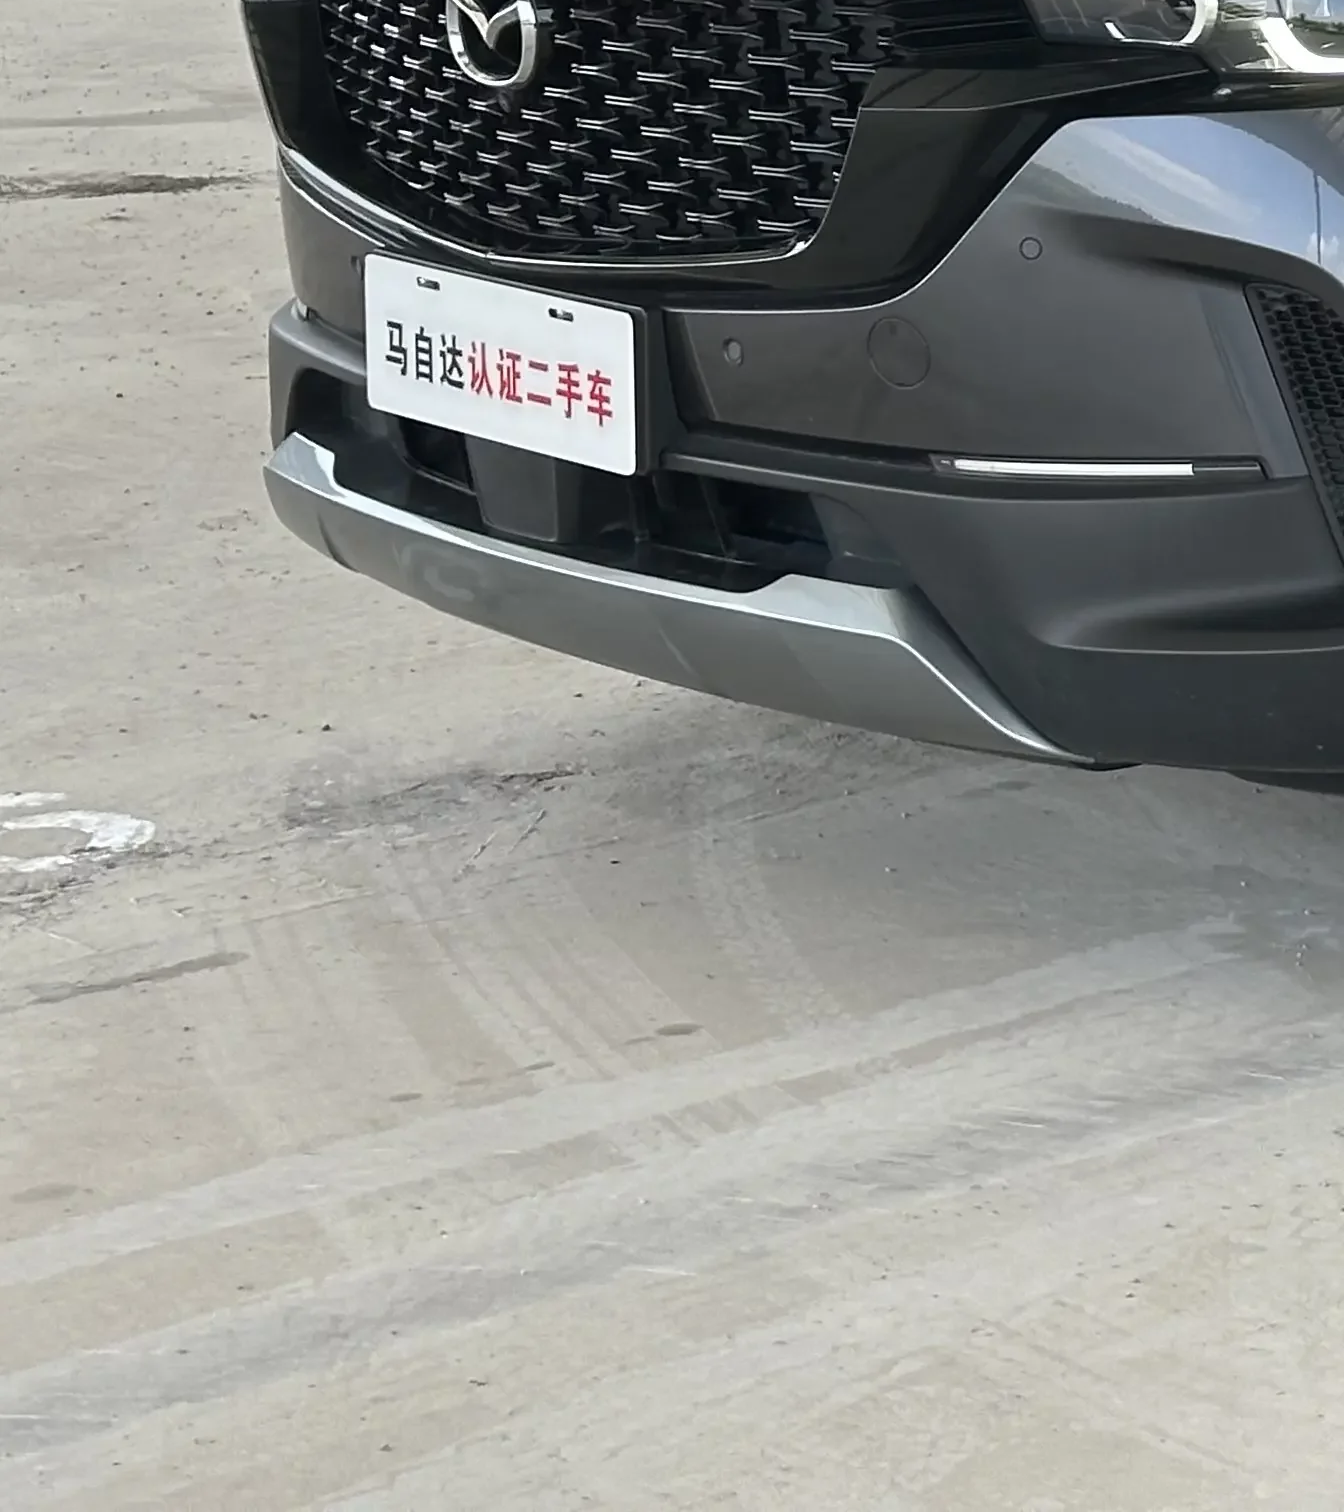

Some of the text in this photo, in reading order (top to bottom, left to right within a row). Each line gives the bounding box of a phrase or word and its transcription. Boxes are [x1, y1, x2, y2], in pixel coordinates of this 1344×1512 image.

[385, 320, 613, 427] 马自达认证二手车
